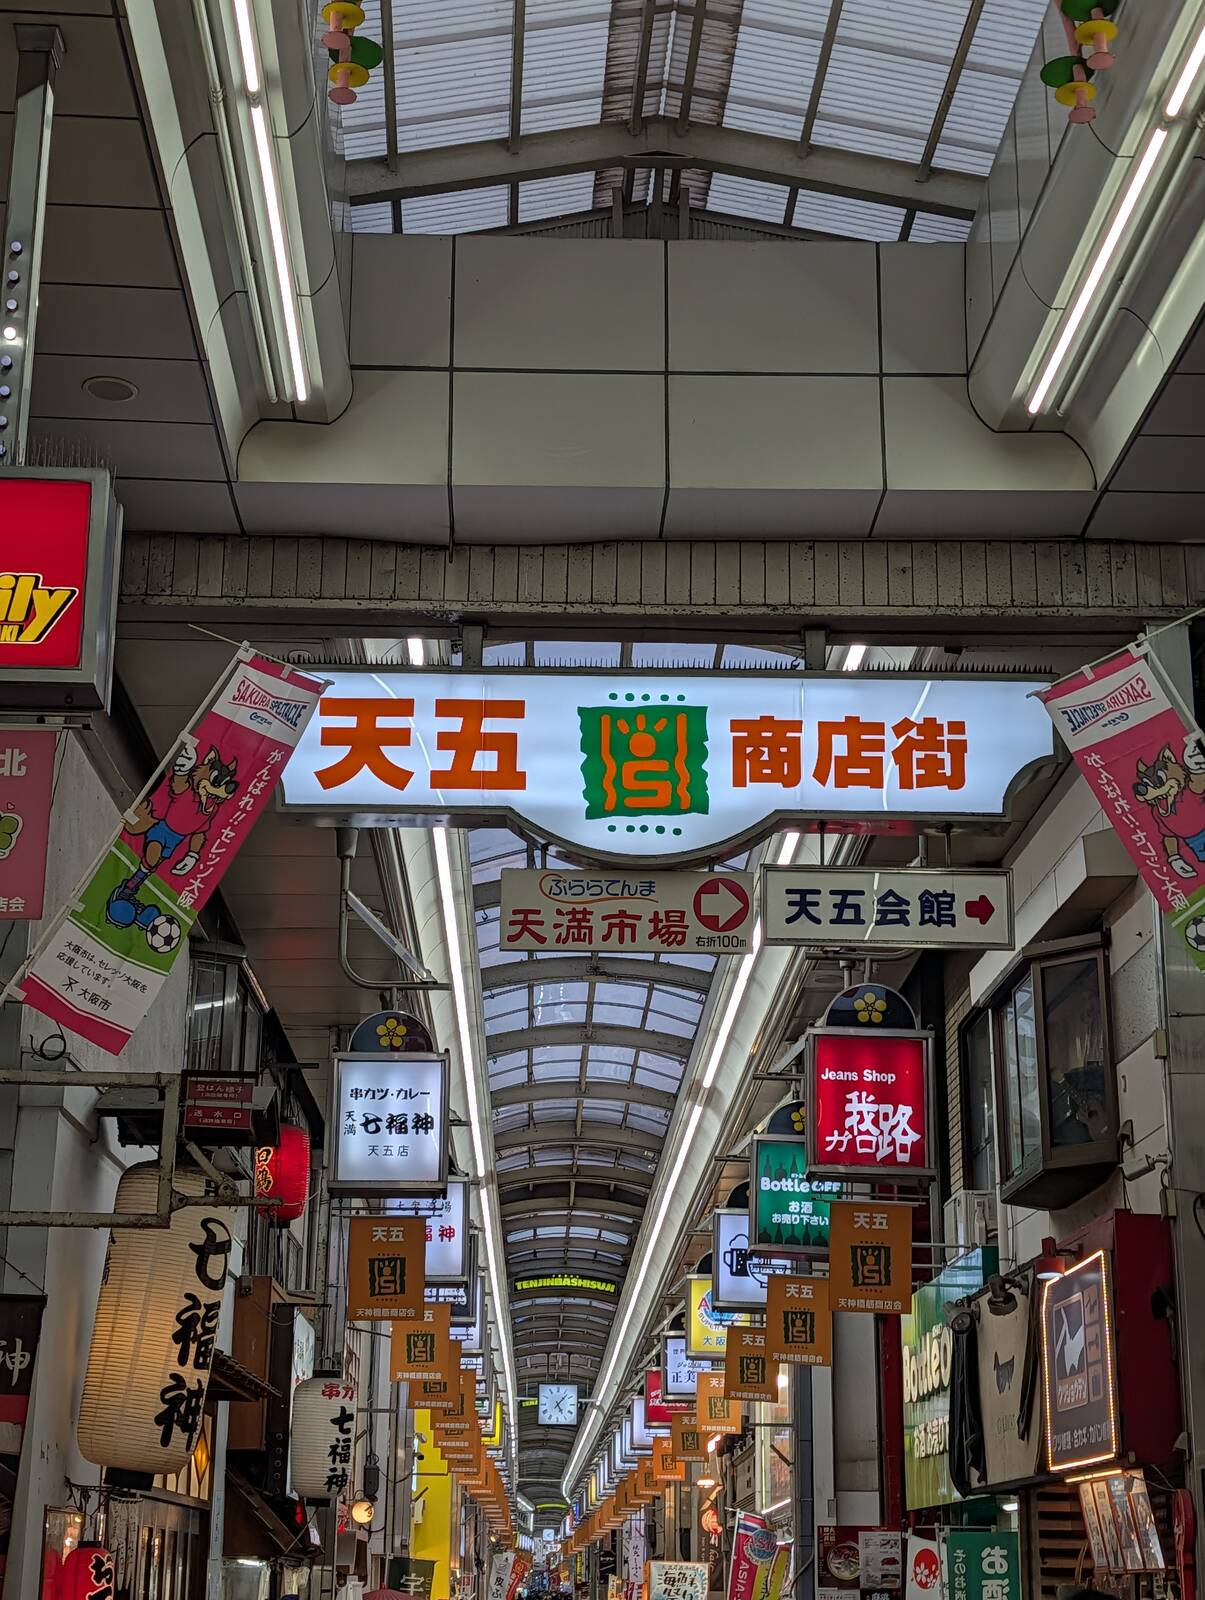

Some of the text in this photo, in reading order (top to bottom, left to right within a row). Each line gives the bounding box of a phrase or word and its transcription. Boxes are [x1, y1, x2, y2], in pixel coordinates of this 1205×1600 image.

[232, 680, 308, 728] SAKURA SPECTACLE
[314, 698, 967, 791] 天五 商店街
[549, 879, 656, 897] ぷららてんま
[785, 888, 956, 928] 天五会館
[506, 907, 690, 947] 天満市場
[77, 987, 113, 1011] 大阪市
[821, 1069, 896, 1083] Jeans Shop
[349, 1087, 430, 1100] 串カツ・カレー
[344, 1110, 357, 1137] 天満
[360, 1112, 435, 1136] 七福神
[367, 1144, 410, 1157] 天五店
[760, 1176, 810, 1193] Bottle
[788, 1201, 813, 1214] お酒
[771, 1213, 829, 1226] お売り下さい
[854, 1213, 888, 1230] 天五
[371, 1226, 405, 1242] 天五
[786, 1284, 814, 1298] 天五
[742, 1334, 765, 1346] 天五
[323, 1406, 354, 1496] 七福神
